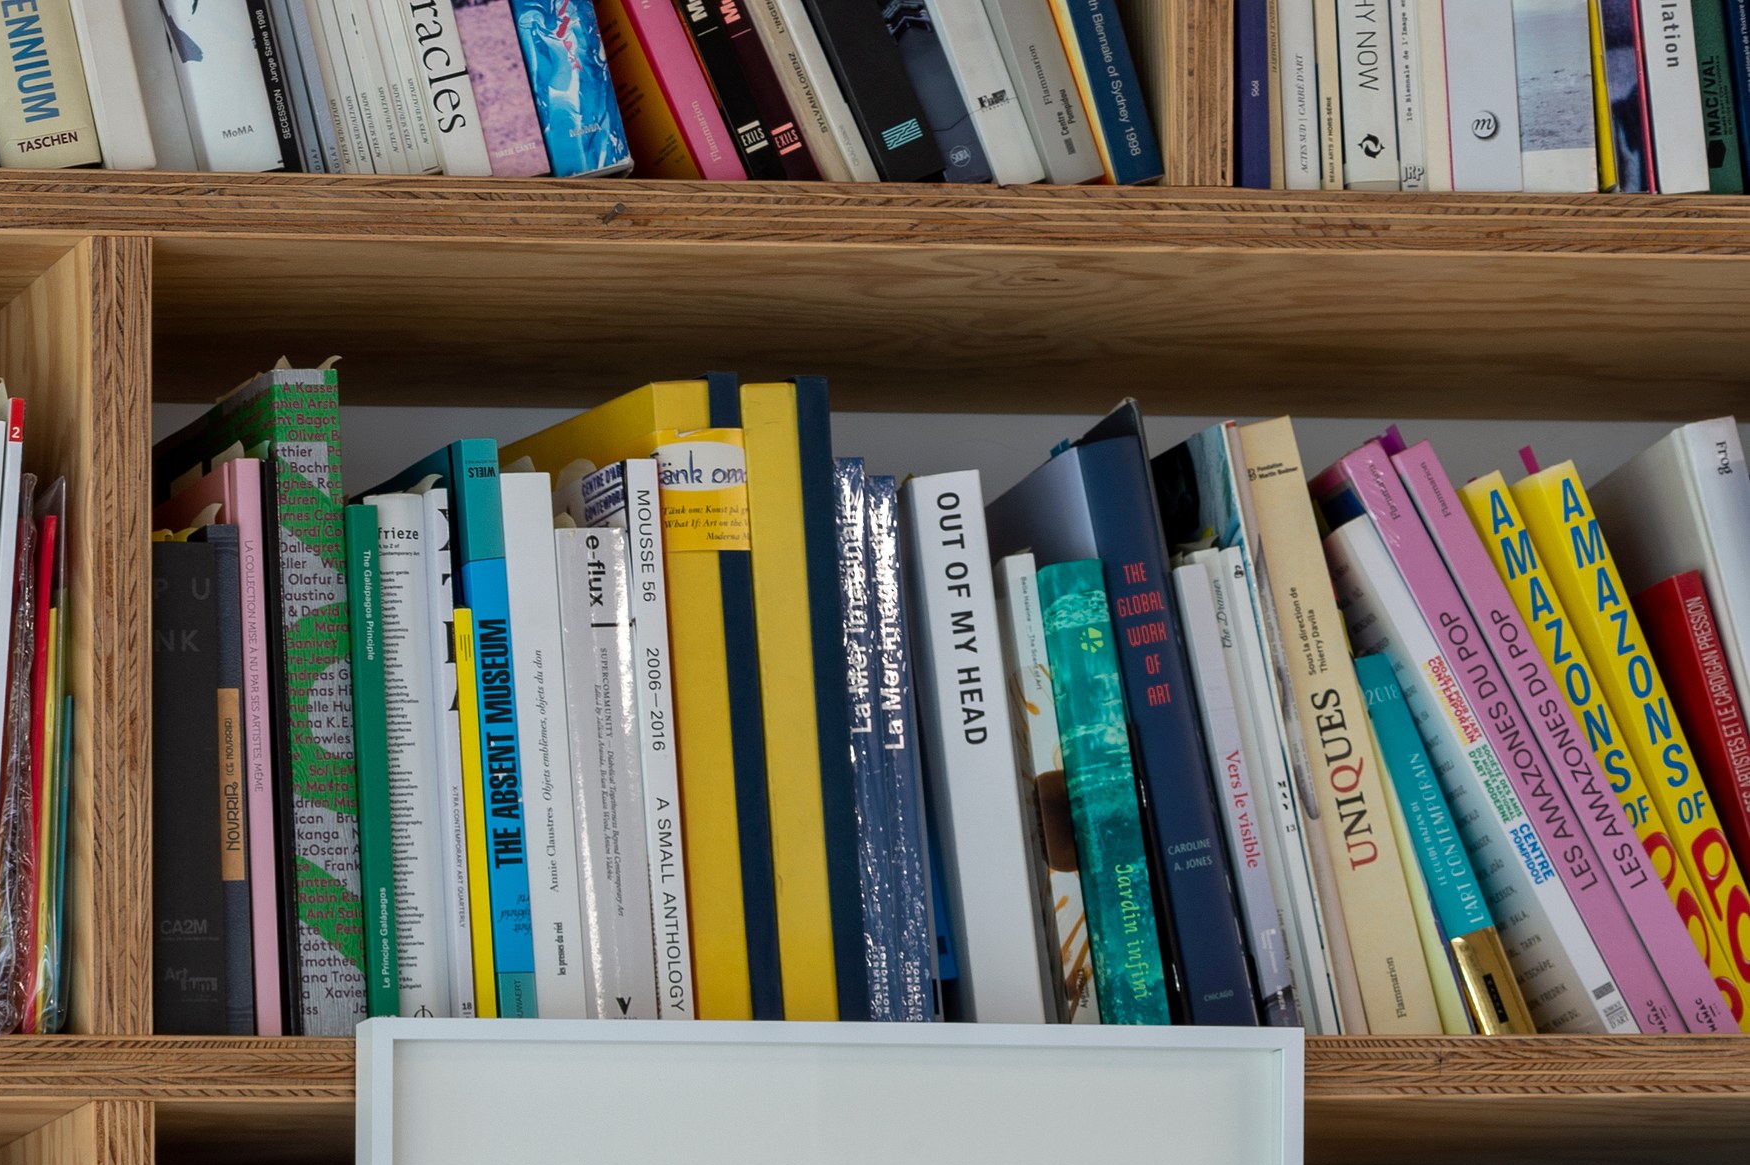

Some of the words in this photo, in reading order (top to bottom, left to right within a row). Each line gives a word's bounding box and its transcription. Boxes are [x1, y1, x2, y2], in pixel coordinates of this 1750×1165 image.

[1028, 45, 1052, 105] Flammarion
[1357, 31, 1381, 92] NOW
[1091, 17, 1114, 64] Biennale
[1110, 79, 1130, 125] Sydney
[1123, 126, 1141, 157] 1998
[1700, 55, 1721, 138] MAC/VAL
[222, 125, 254, 139] MoMA
[272, 89, 292, 140] SECESSION
[1058, 111, 1069, 137] Centre
[17, 131, 79, 154] TASCHEN
[287, 429, 329, 441] Oliver
[296, 413, 337, 425] Bagot
[467, 466, 496, 478] WIELS
[636, 488, 657, 574] MOUSSE
[936, 491, 966, 550] OUT
[287, 573, 332, 586] Olafur
[362, 549, 372, 565] The
[585, 534, 604, 608] e-flux
[944, 561, 971, 598] OF
[1122, 561, 1147, 584] THE
[363, 565, 375, 620] Galápagos
[641, 580, 657, 604] 56
[1116, 591, 1165, 617] GLOBAL
[365, 620, 376, 661] Principle
[950, 609, 979, 655] MY
[1126, 622, 1168, 646] WORK
[1308, 609, 1320, 639] Davila
[1439, 611, 1477, 661] POP
[478, 617, 513, 728] MUSEUM
[1144, 653, 1162, 675] OF
[1561, 477, 1689, 788] AMAZONS
[1676, 790, 1705, 825] OF
[1146, 682, 1172, 707] ART
[1467, 662, 1499, 699] DU
[957, 668, 988, 746] HEAD
[295, 732, 352, 745] Knowles
[487, 731, 521, 822] ABSENT
[1310, 687, 1379, 871] UNIQUES
[1488, 701, 1574, 840] AMAZONES
[226, 781, 243, 852] NOURRIR
[543, 806, 556, 858] Claustres
[1225, 750, 1242, 790] Vers
[1235, 808, 1259, 869] visible
[495, 827, 524, 870] THE
[657, 817, 675, 885] SMALL
[1167, 838, 1212, 856] CAROLINE
[1509, 828, 1544, 885] POMPIDOU
[1518, 823, 1555, 881] CENTRE
[1563, 844, 1598, 891] LES
[549, 860, 559, 893] Annie
[378, 887, 389, 940] Galápagos
[380, 942, 391, 979] Principe
[662, 890, 686, 1013] ANTHOLOGY
[1203, 989, 1234, 1002] CHICAGO
[1386, 956, 1407, 1019] Flammarion
